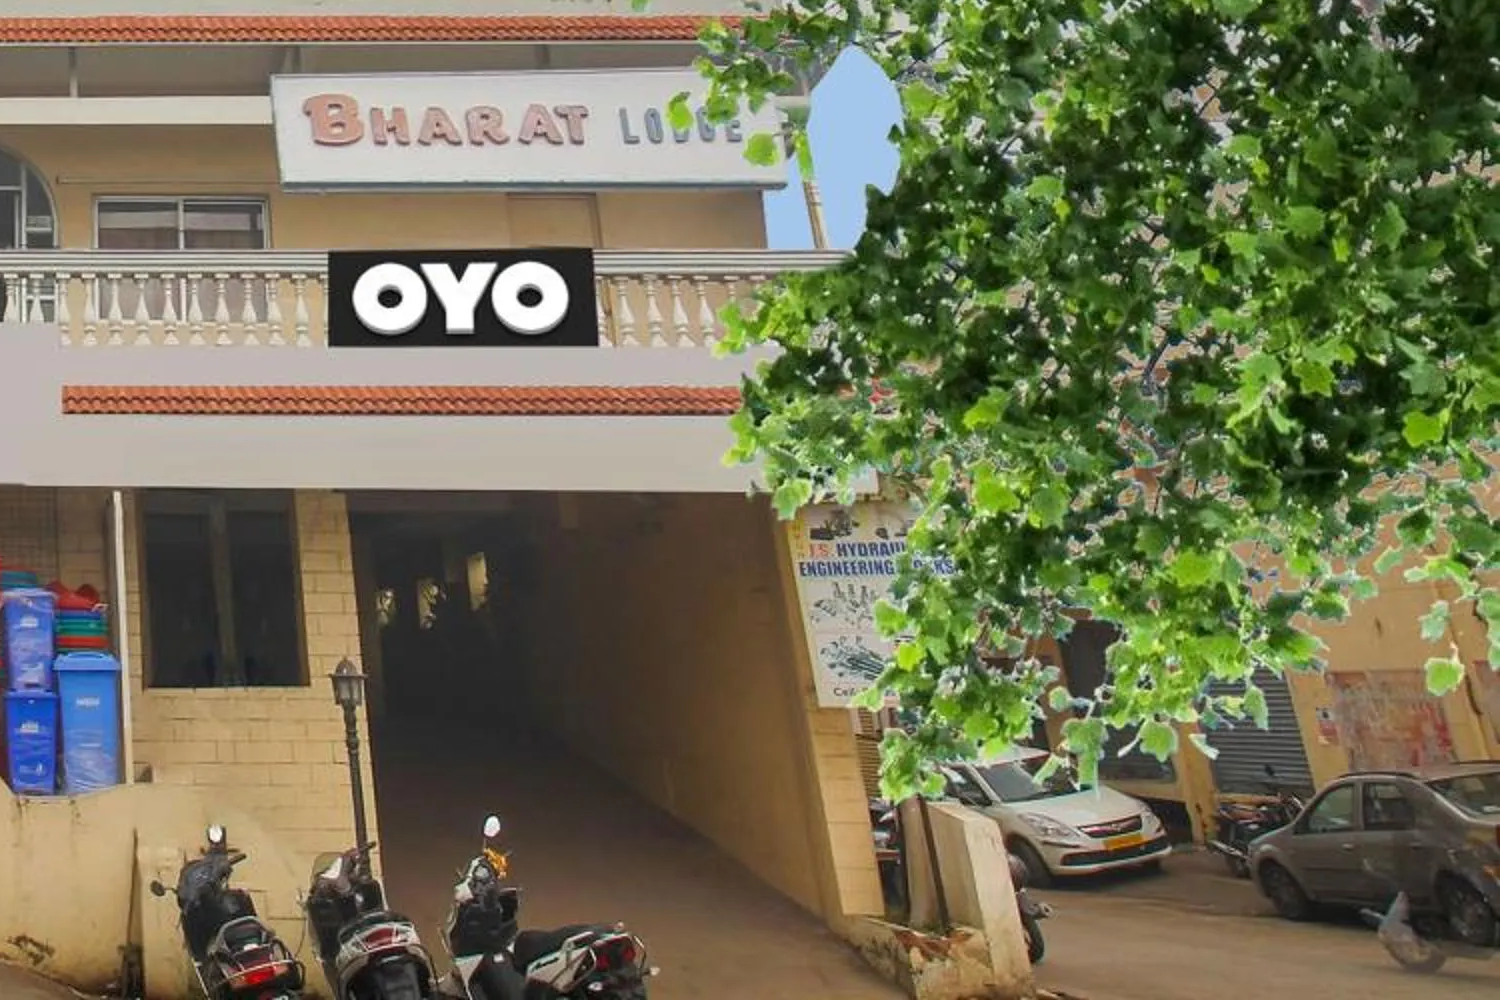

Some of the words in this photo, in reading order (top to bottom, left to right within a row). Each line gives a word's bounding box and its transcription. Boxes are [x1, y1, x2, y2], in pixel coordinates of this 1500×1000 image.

[303, 93, 589, 147] BHARAT
[352, 260, 570, 336] OYO
[798, 559, 896, 578] ENGINEERING
